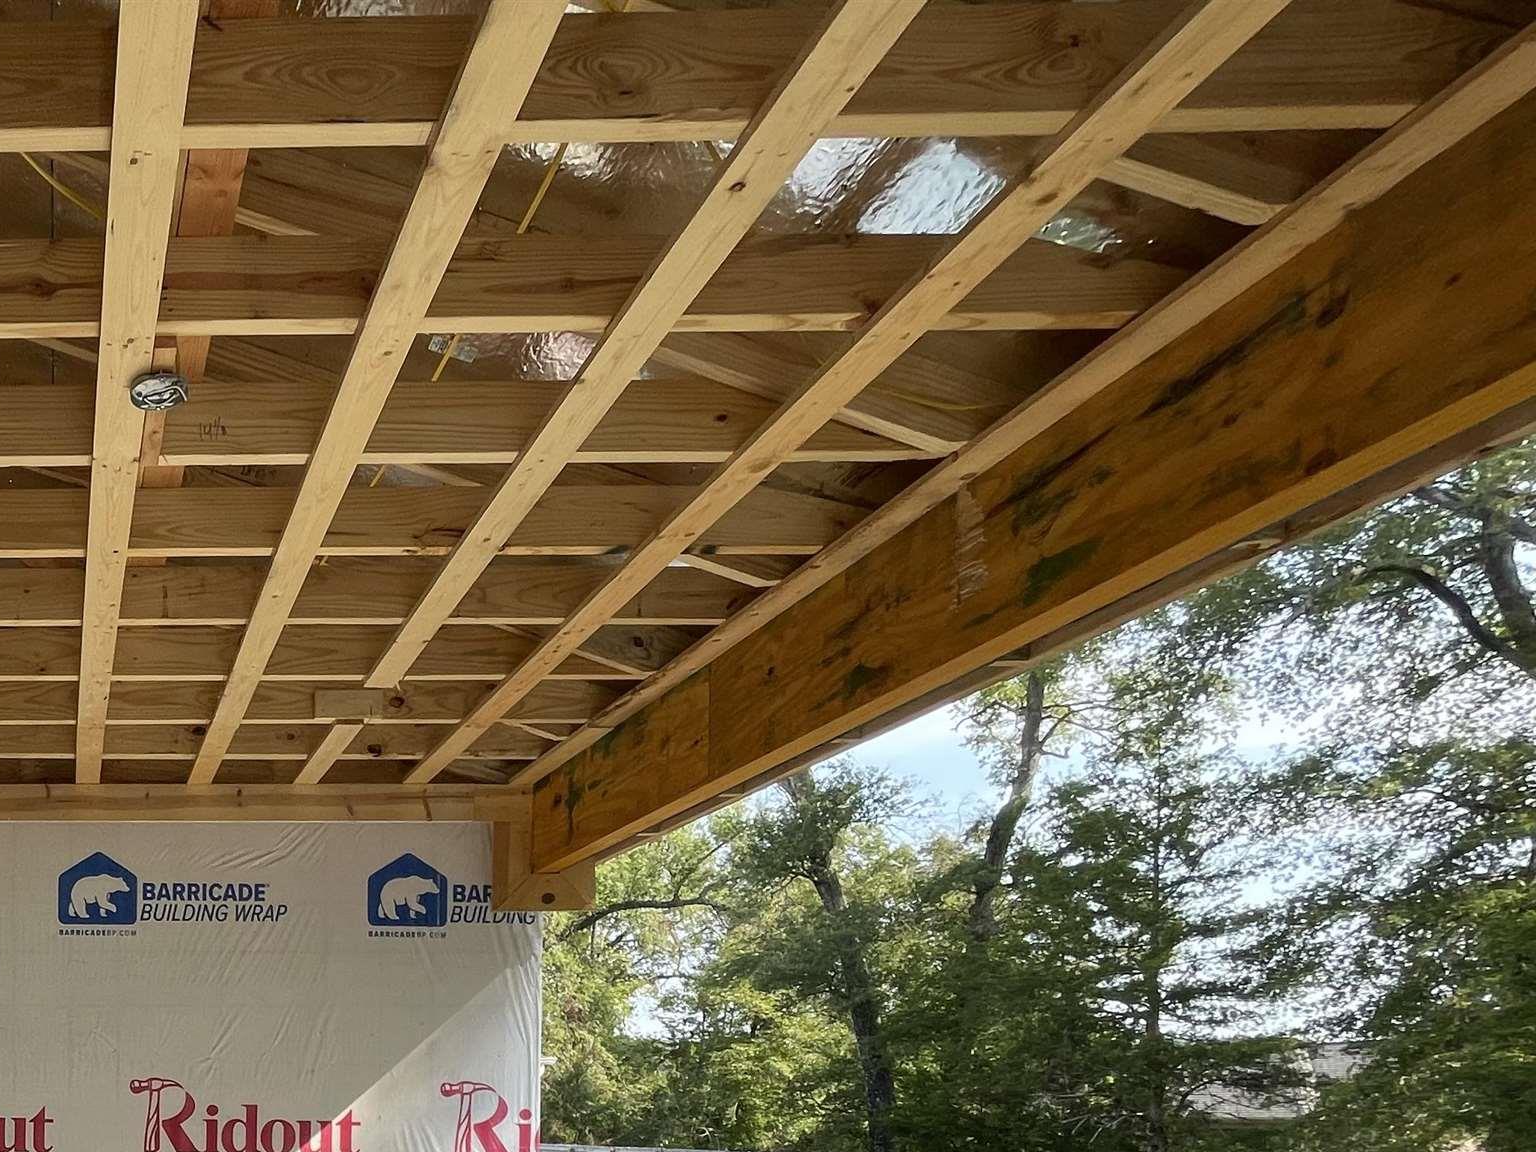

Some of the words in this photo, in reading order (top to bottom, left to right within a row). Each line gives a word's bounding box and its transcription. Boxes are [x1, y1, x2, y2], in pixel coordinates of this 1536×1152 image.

[141, 882, 266, 902] BARRICADE
[140, 903, 229, 923] BUILDING
[235, 904, 288, 923] WRAP
